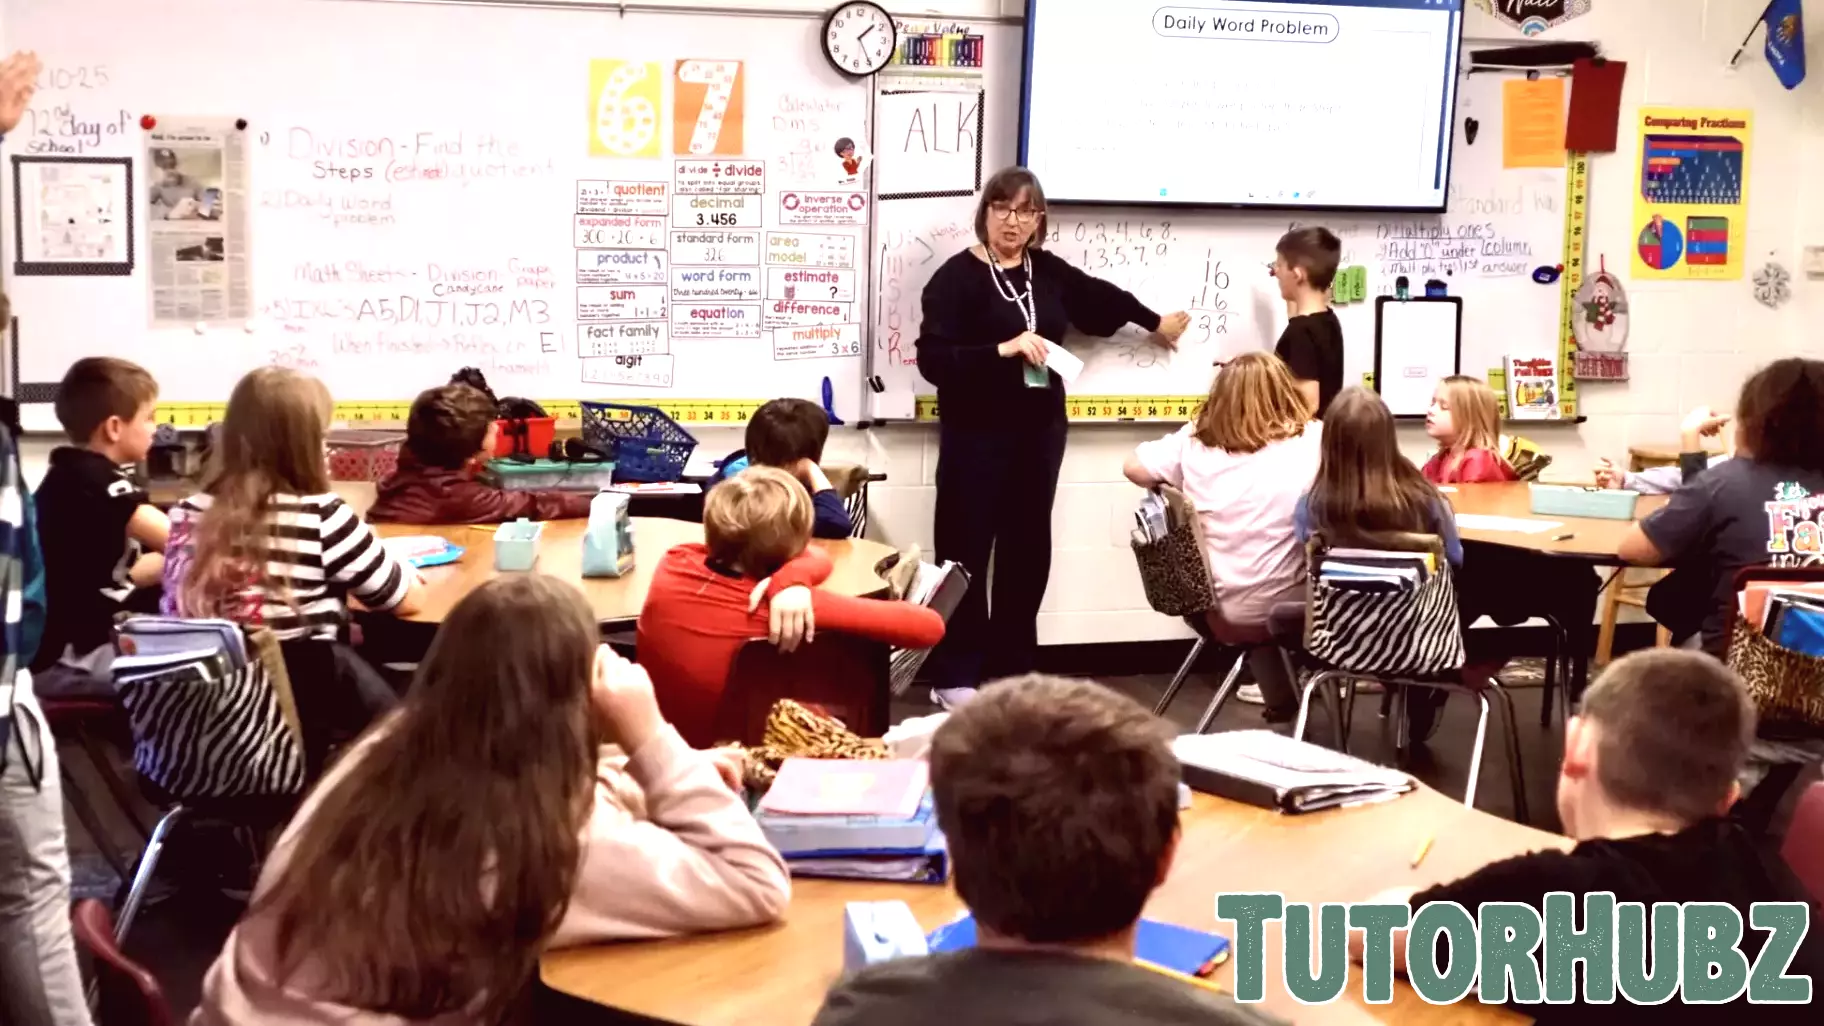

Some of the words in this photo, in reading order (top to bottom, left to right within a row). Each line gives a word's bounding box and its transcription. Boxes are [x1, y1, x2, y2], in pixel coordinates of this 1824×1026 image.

[856, 8, 864, 17] 12
[835, 20, 844, 29] 10
[878, 23, 885, 31] 2
[1164, 14, 1206, 33] Daily
[1213, 17, 1254, 33] Word
[1261, 19, 1329, 36] Problem
[831, 32, 837, 40] 9
[833, 45, 840, 53] 8
[876, 49, 882, 57] 4
[853, 60, 859, 68] 6
[597, 62, 656, 156] 6
[678, 59, 739, 155] 7
[59, 114, 101, 147] day
[106, 109, 132, 136] of
[904, 101, 978, 154] ALK
[1644, 115, 1698, 130] Comparing
[1700, 117, 1746, 129] Fractions
[25, 138, 83, 154] school
[287, 126, 395, 160] Division
[415, 131, 462, 156] Find
[312, 160, 374, 183] Steps
[724, 164, 763, 177] divide
[614, 183, 665, 197] quotient
[342, 193, 393, 211] Word
[690, 195, 745, 209] decimal
[798, 204, 848, 215] operation
[578, 216, 631, 228] expanded
[635, 217, 662, 228] form
[696, 212, 737, 226] 3.456
[676, 232, 724, 244] standard
[727, 232, 754, 244] form
[769, 236, 800, 248] area
[597, 251, 649, 267] product
[768, 251, 807, 263] model
[428, 262, 498, 284] Division
[681, 269, 715, 283] word
[719, 269, 752, 283] form
[783, 270, 839, 283] estimate
[1204, 260, 1230, 290] 16
[609, 289, 636, 301] sum
[829, 286, 838, 299] ?
[509, 299, 551, 324] M3
[660, 306, 667, 317] 2
[690, 306, 745, 321] equation
[773, 300, 840, 316] difference
[587, 325, 614, 339] fact
[619, 323, 660, 340] family
[792, 325, 842, 341] multiply
[1199, 313, 1228, 344] 32
[831, 342, 839, 354] 3
[850, 341, 859, 354] 6
[704, 411, 713, 421] 34
[720, 411, 730, 421] 35
[737, 411, 747, 421] 36
[1072, 406, 1080, 416] 51
[1087, 406, 1097, 416] 52
[1103, 406, 1112, 416] 53
[1118, 406, 1127, 416] 54
[1133, 406, 1142, 416] 55
[1148, 406, 1157, 416] 56
[1163, 406, 1172, 416] 57
[1178, 406, 1188, 416] 58
